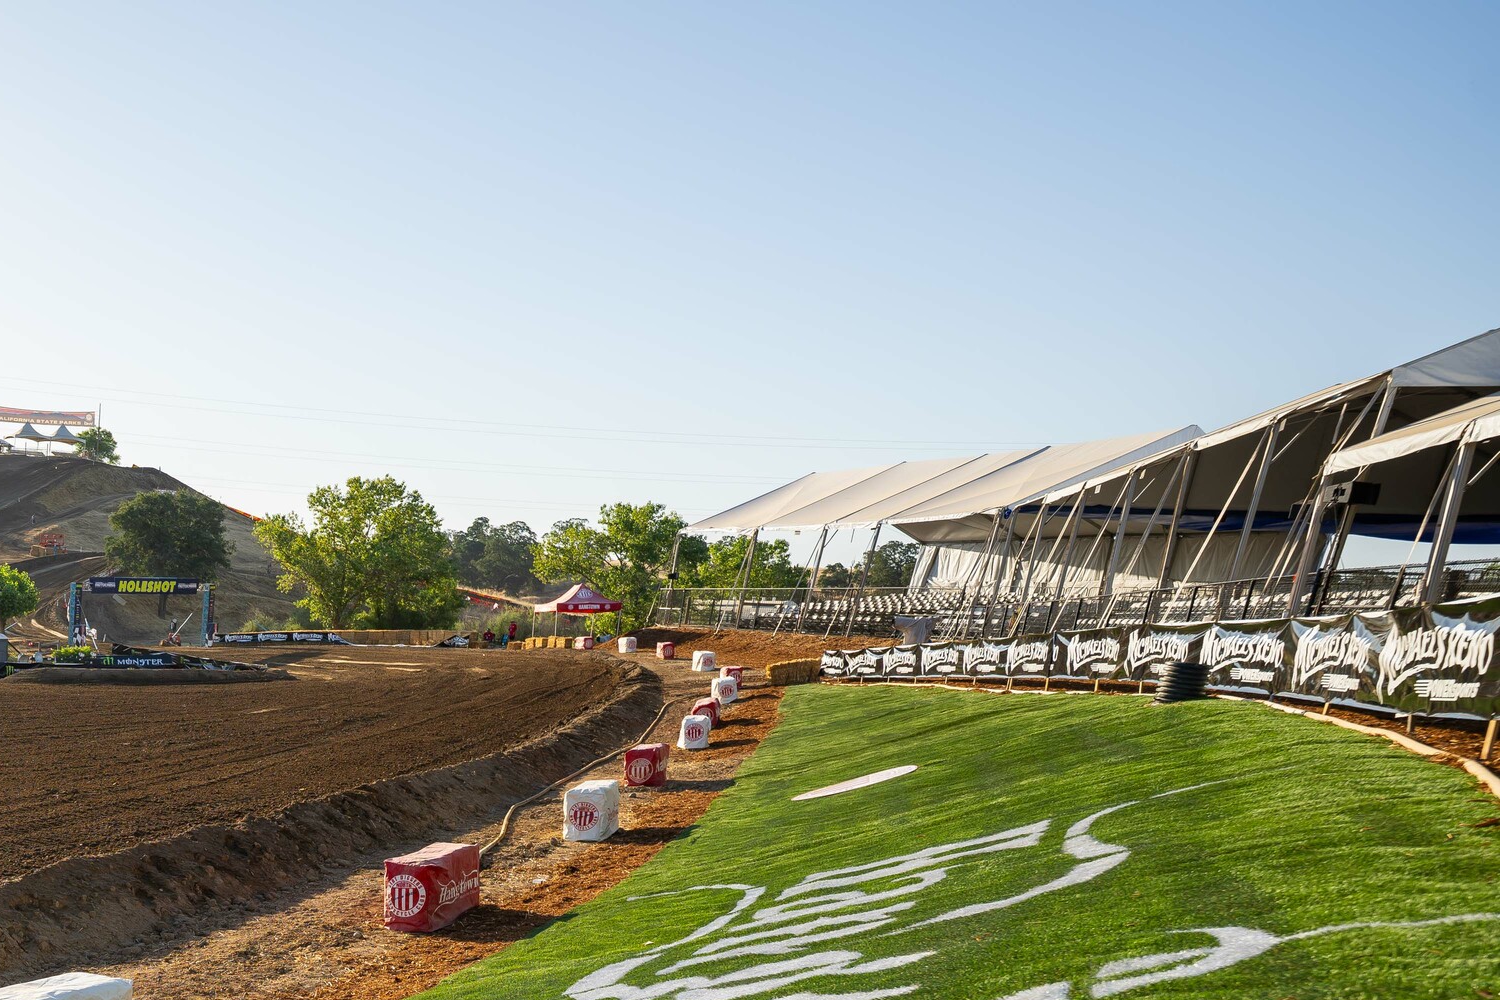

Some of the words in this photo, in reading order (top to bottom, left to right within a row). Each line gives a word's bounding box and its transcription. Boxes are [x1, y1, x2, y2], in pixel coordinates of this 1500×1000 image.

[118, 580, 176, 593] HOLESHOT
[117, 657, 164, 666] MONSTER
[1250, 633, 1285, 669] RENO
[1341, 630, 1372, 675] RENO
[1441, 622, 1495, 676] RENO
[1426, 678, 1481, 702] POWERSPORTS
[437, 871, 479, 906] Hangtown
